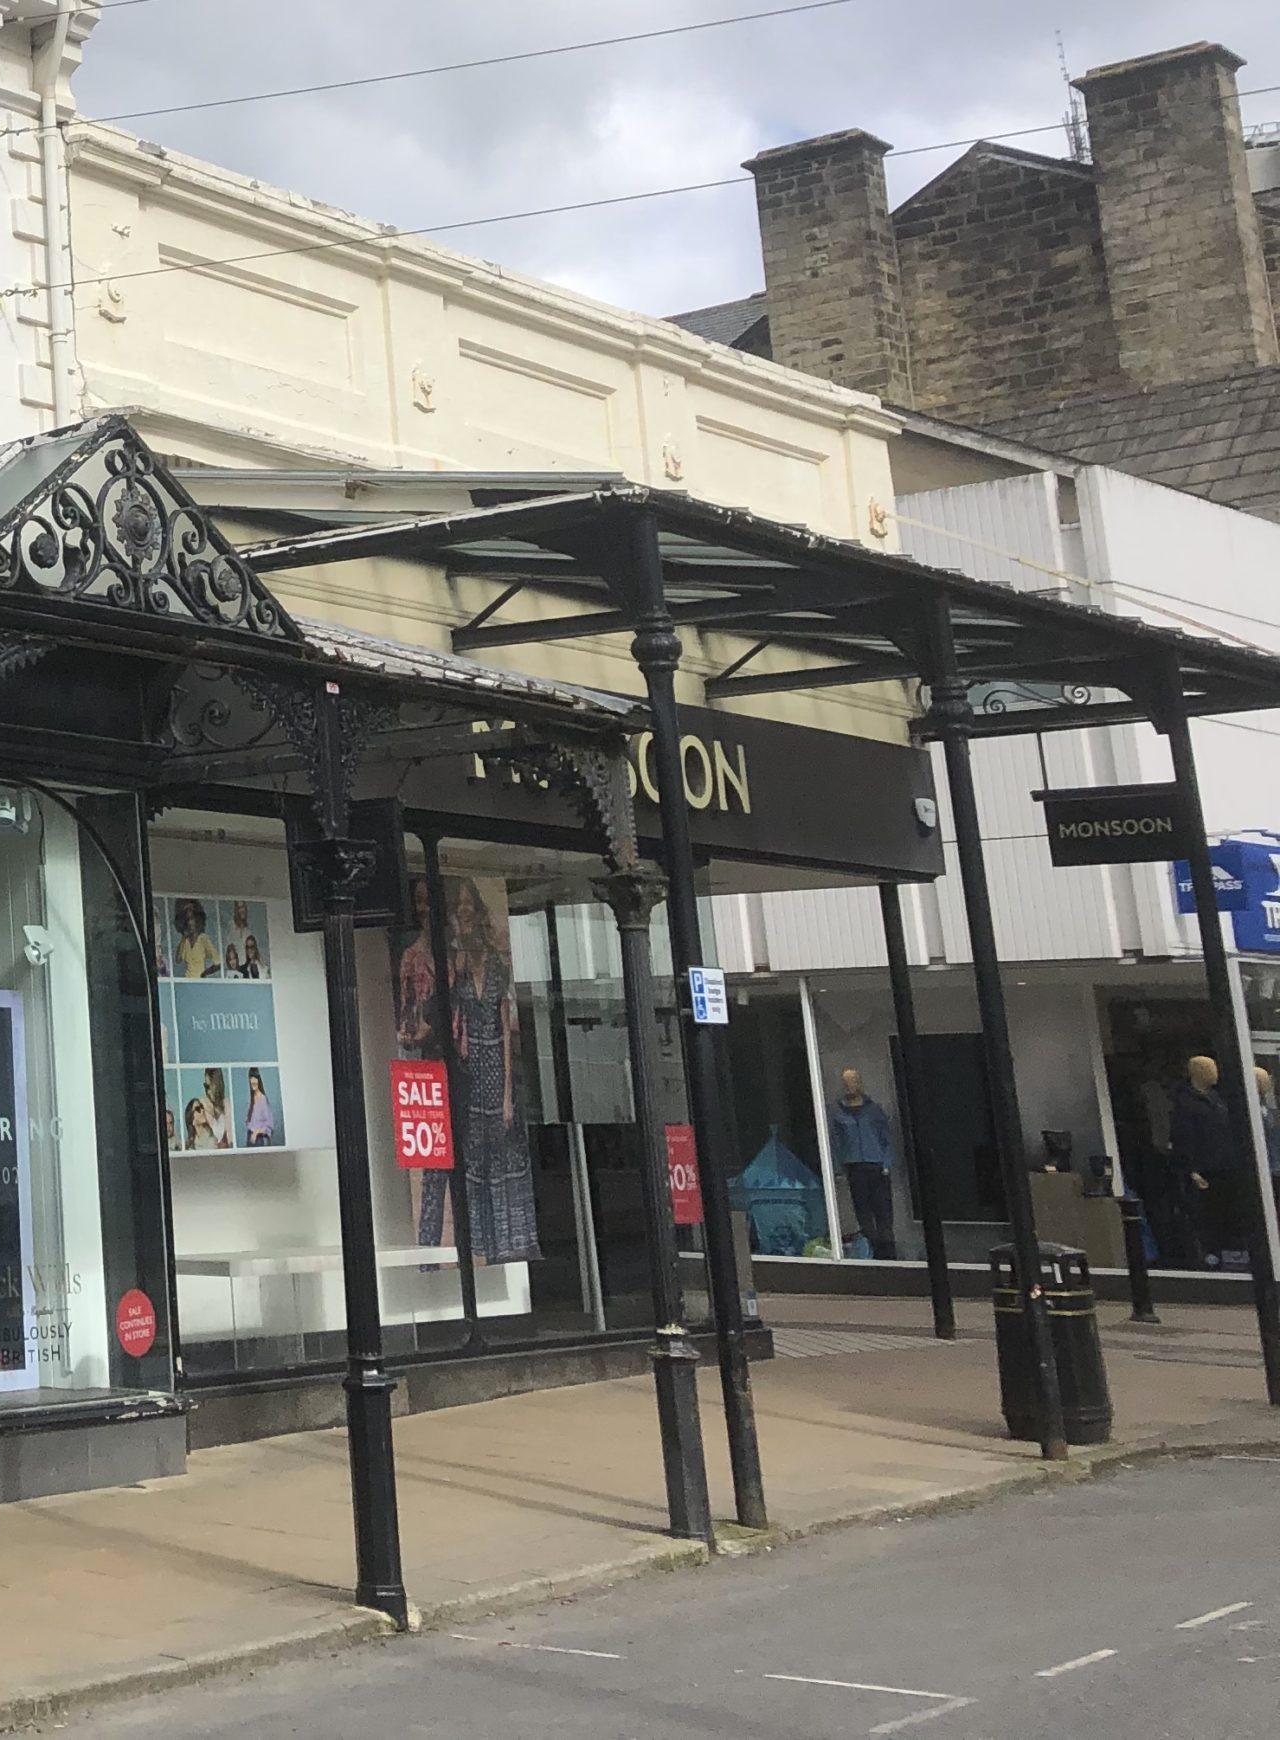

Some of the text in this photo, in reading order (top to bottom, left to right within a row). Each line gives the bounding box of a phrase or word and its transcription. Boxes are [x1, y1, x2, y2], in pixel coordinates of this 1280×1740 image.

[1059, 817, 1172, 838] MONSOON
[210, 1011, 258, 1030] mama
[398, 1081, 443, 1107] SALE
[401, 1121, 447, 1157] 50%
[433, 1147, 448, 1158] OFF
[0, 1343, 62, 1366] BRTISH
